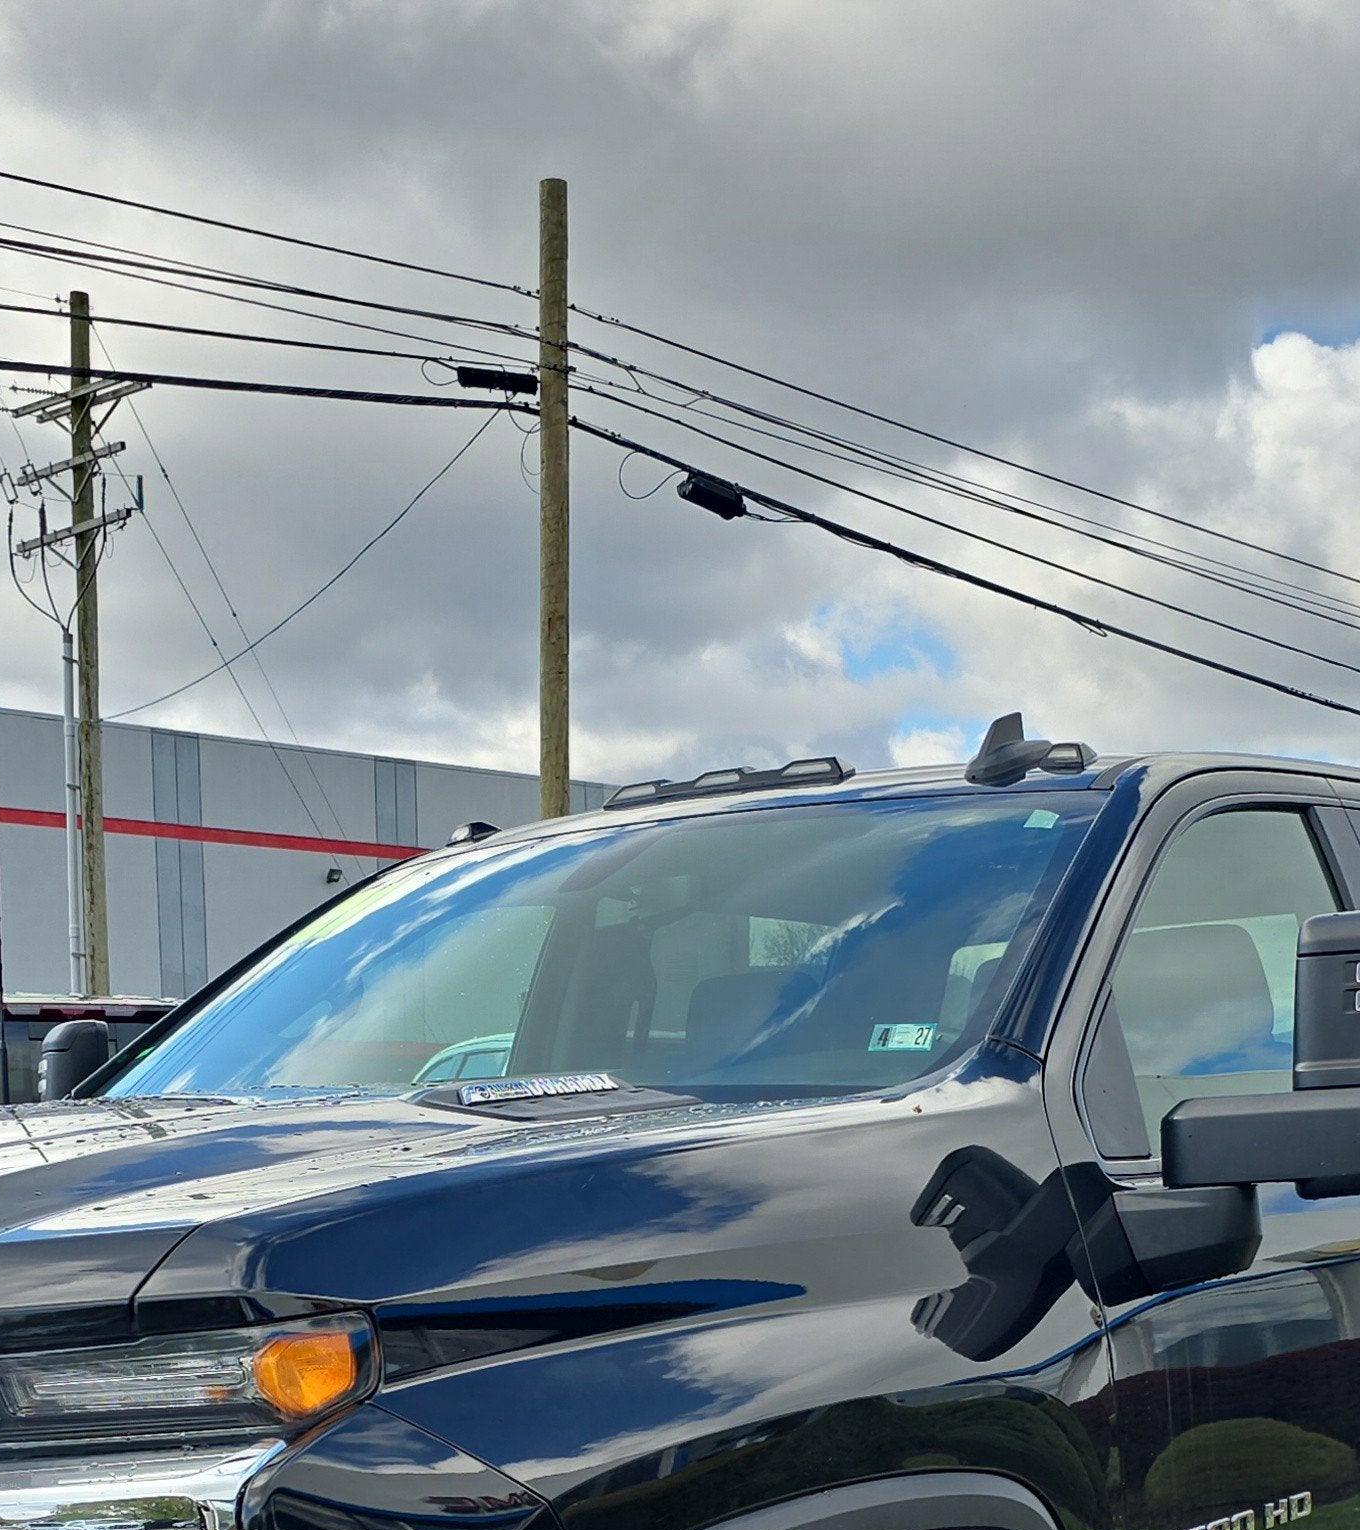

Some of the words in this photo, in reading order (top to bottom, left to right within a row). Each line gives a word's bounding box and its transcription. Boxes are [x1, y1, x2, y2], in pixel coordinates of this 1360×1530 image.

[877, 1026, 891, 1048] 4
[914, 1026, 932, 1046] 27
[1263, 1490, 1312, 1530] HD
